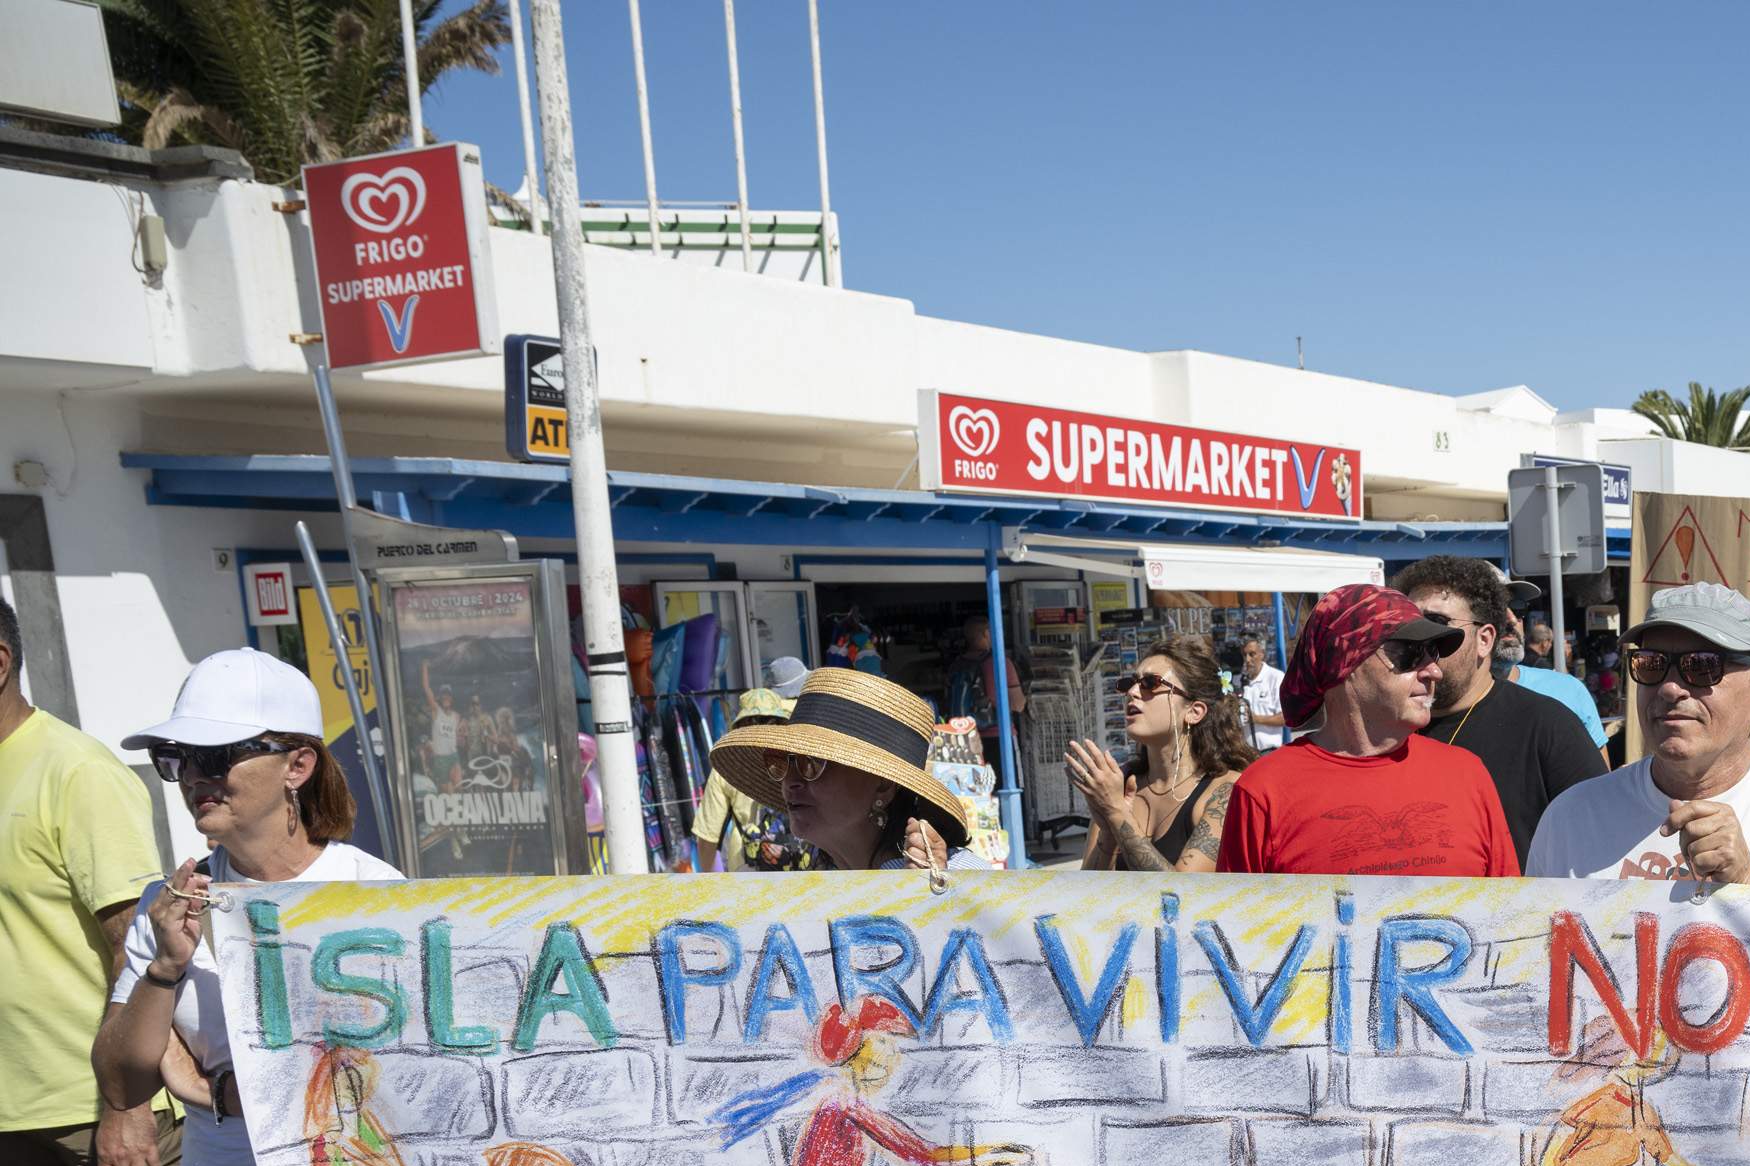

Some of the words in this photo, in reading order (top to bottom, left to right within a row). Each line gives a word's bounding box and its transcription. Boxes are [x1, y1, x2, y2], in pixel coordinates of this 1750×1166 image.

[355, 235, 425, 266] FRIGO
[327, 265, 464, 304] SUPERMARKET
[530, 416, 569, 448] AT
[954, 459, 998, 481] FRIGO
[1025, 418, 1288, 501] SUPERMARKET
[416, 544, 435, 556] DEL
[257, 574, 287, 612] Bild
[653, 913, 1015, 1048] PARA
